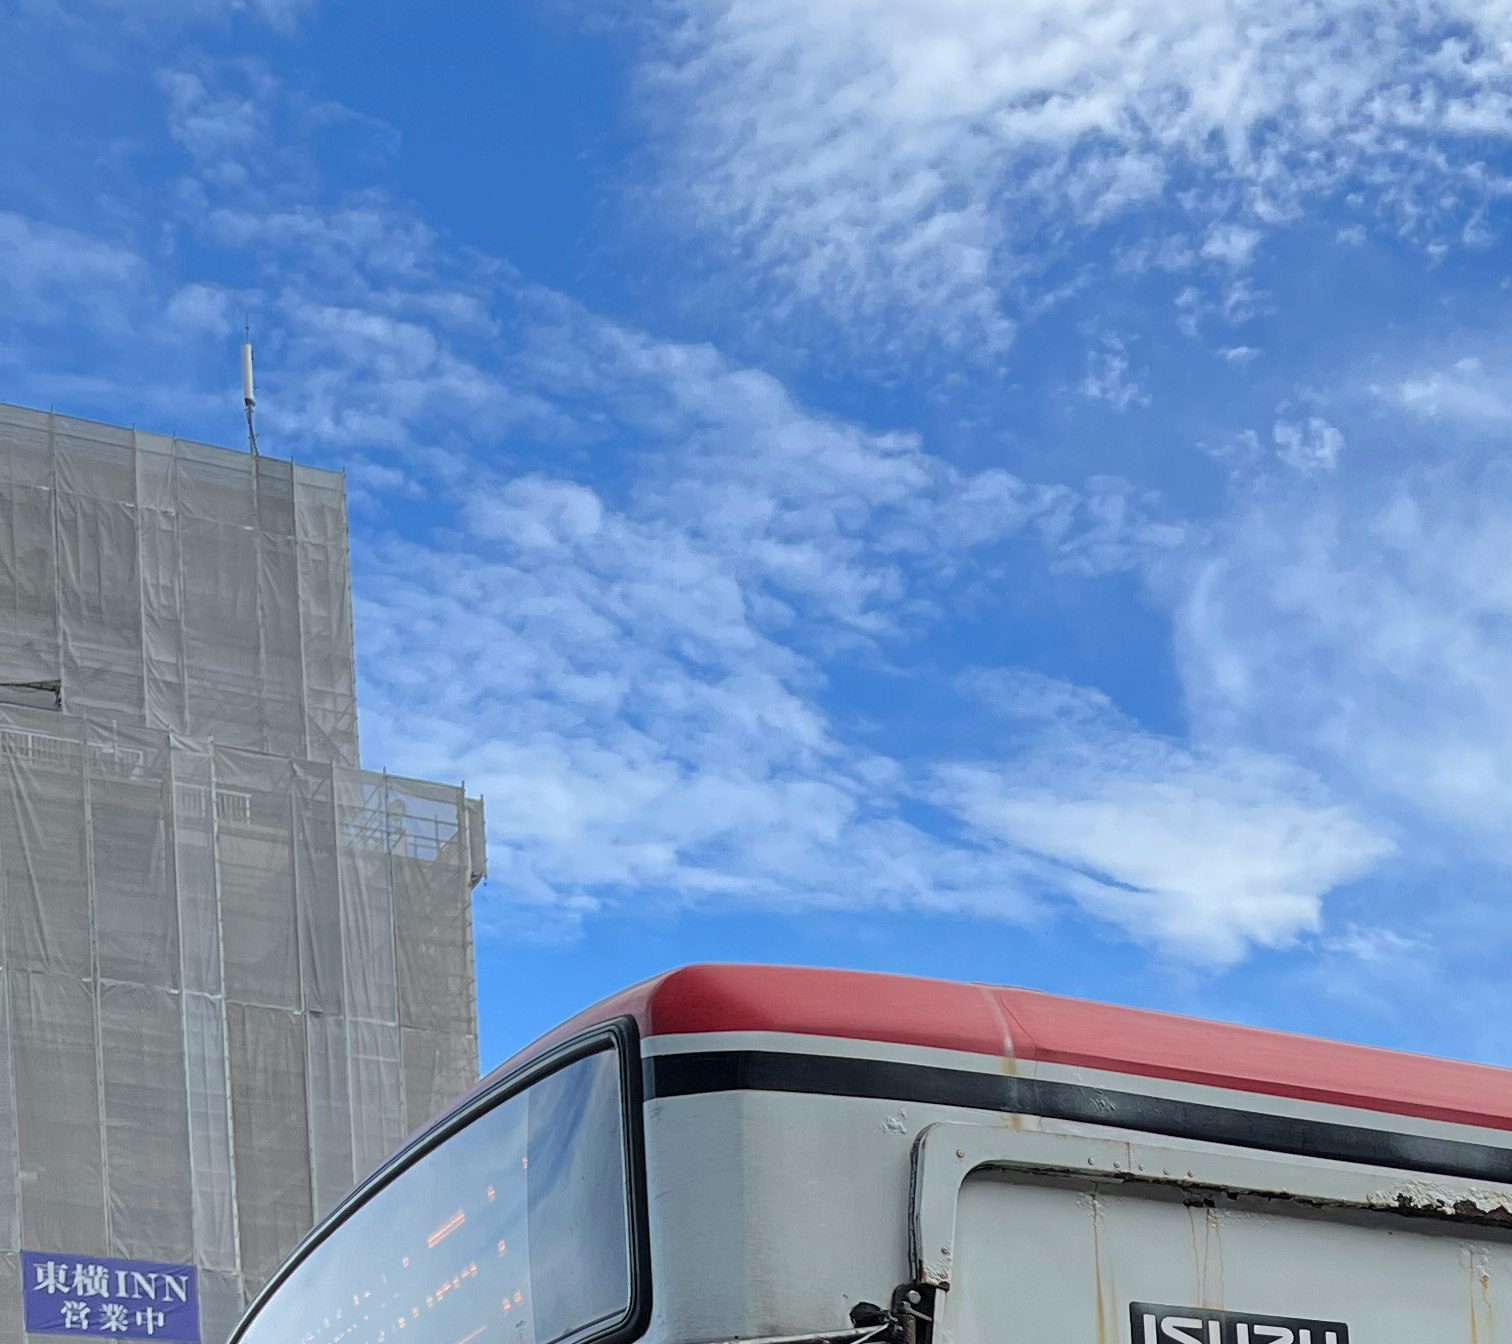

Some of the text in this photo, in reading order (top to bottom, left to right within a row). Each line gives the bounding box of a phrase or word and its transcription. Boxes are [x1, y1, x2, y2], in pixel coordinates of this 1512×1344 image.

[33, 1260, 190, 1302] 東横INN
[60, 1299, 165, 1335] 営業中
